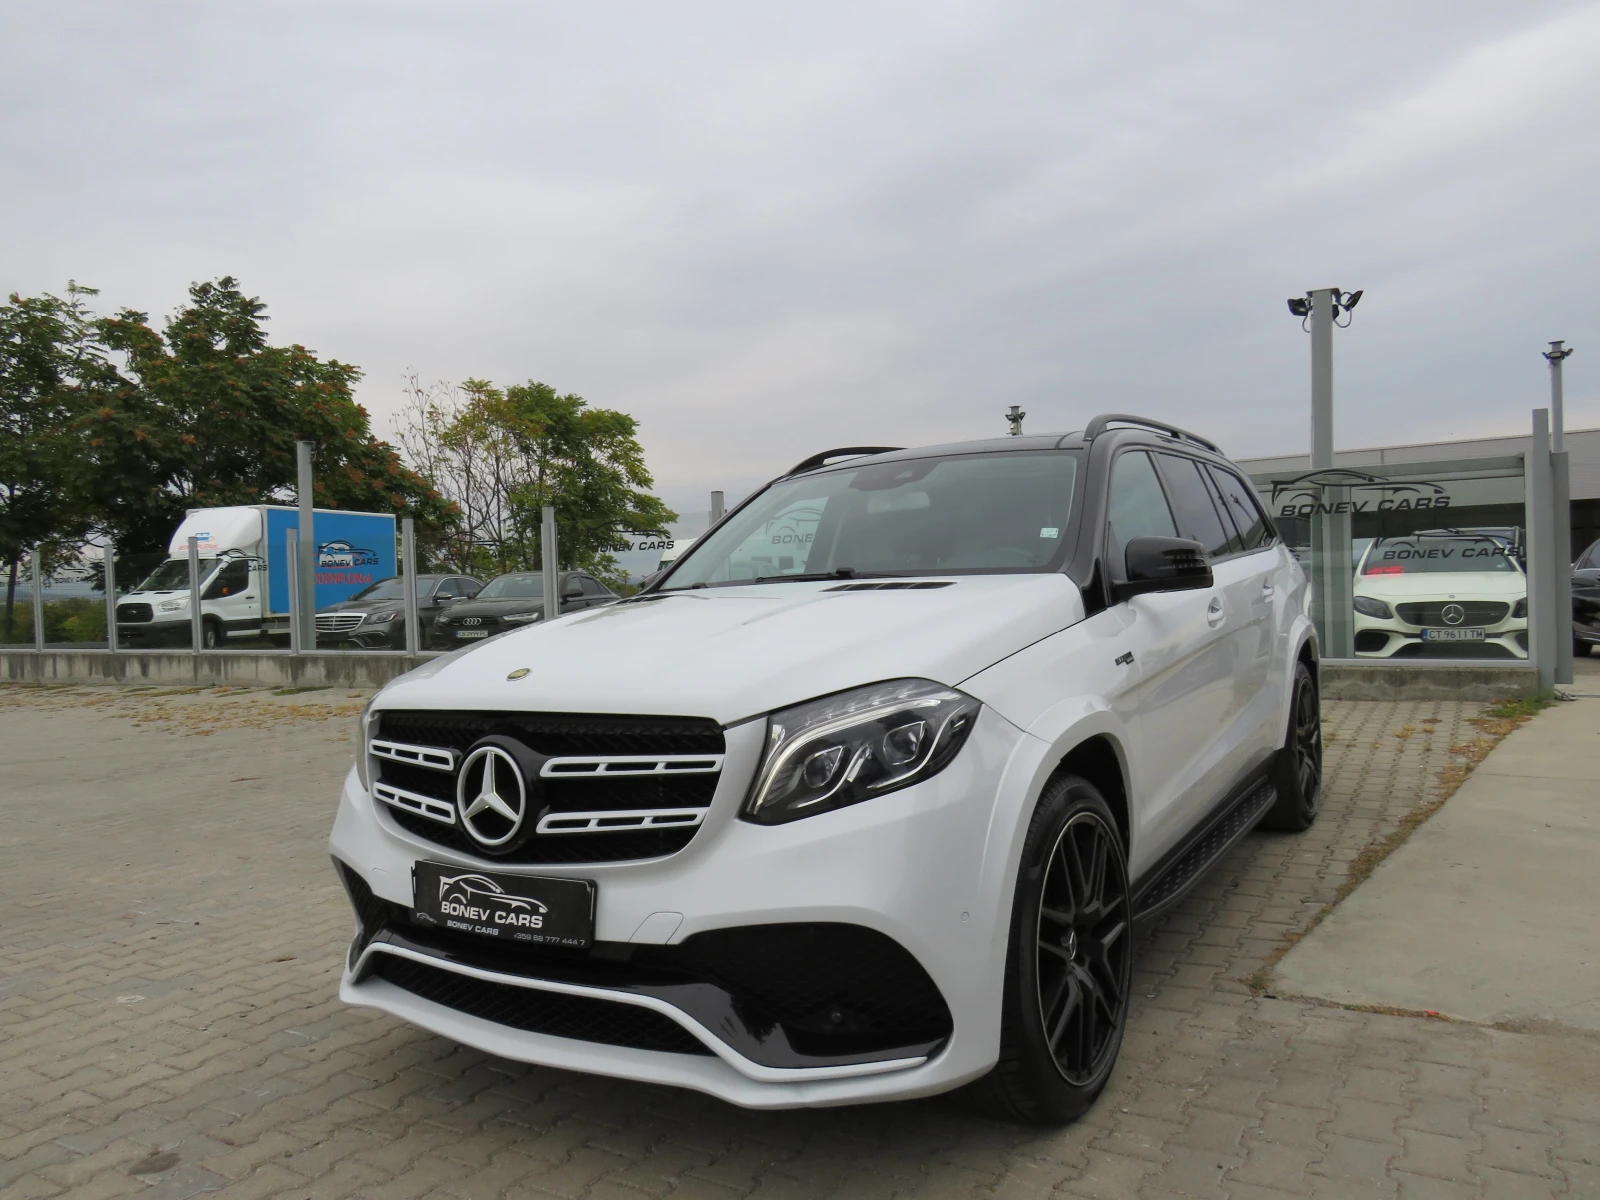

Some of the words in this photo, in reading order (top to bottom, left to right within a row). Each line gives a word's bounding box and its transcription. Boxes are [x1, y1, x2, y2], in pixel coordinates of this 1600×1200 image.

[1280, 500, 1369, 517] BONEV
[1377, 496, 1451, 512] CARS
[771, 533, 814, 545] BONE
[638, 540, 675, 551] CARS
[1382, 549, 1455, 560] BONEV
[1461, 546, 1520, 558] CARS
[321, 559, 352, 568] BONEV
[353, 557, 379, 566] CARS
[1428, 630, 1442, 640] CT
[1444, 630, 1468, 640] 9611
[1470, 630, 1483, 639] TM
[441, 901, 490, 920] BONEV
[494, 911, 543, 928] CARS
[447, 920, 473, 931] BONEV
[475, 925, 498, 935] CARS
[545, 935, 560, 944] 777
[561, 938, 578, 946] 444
